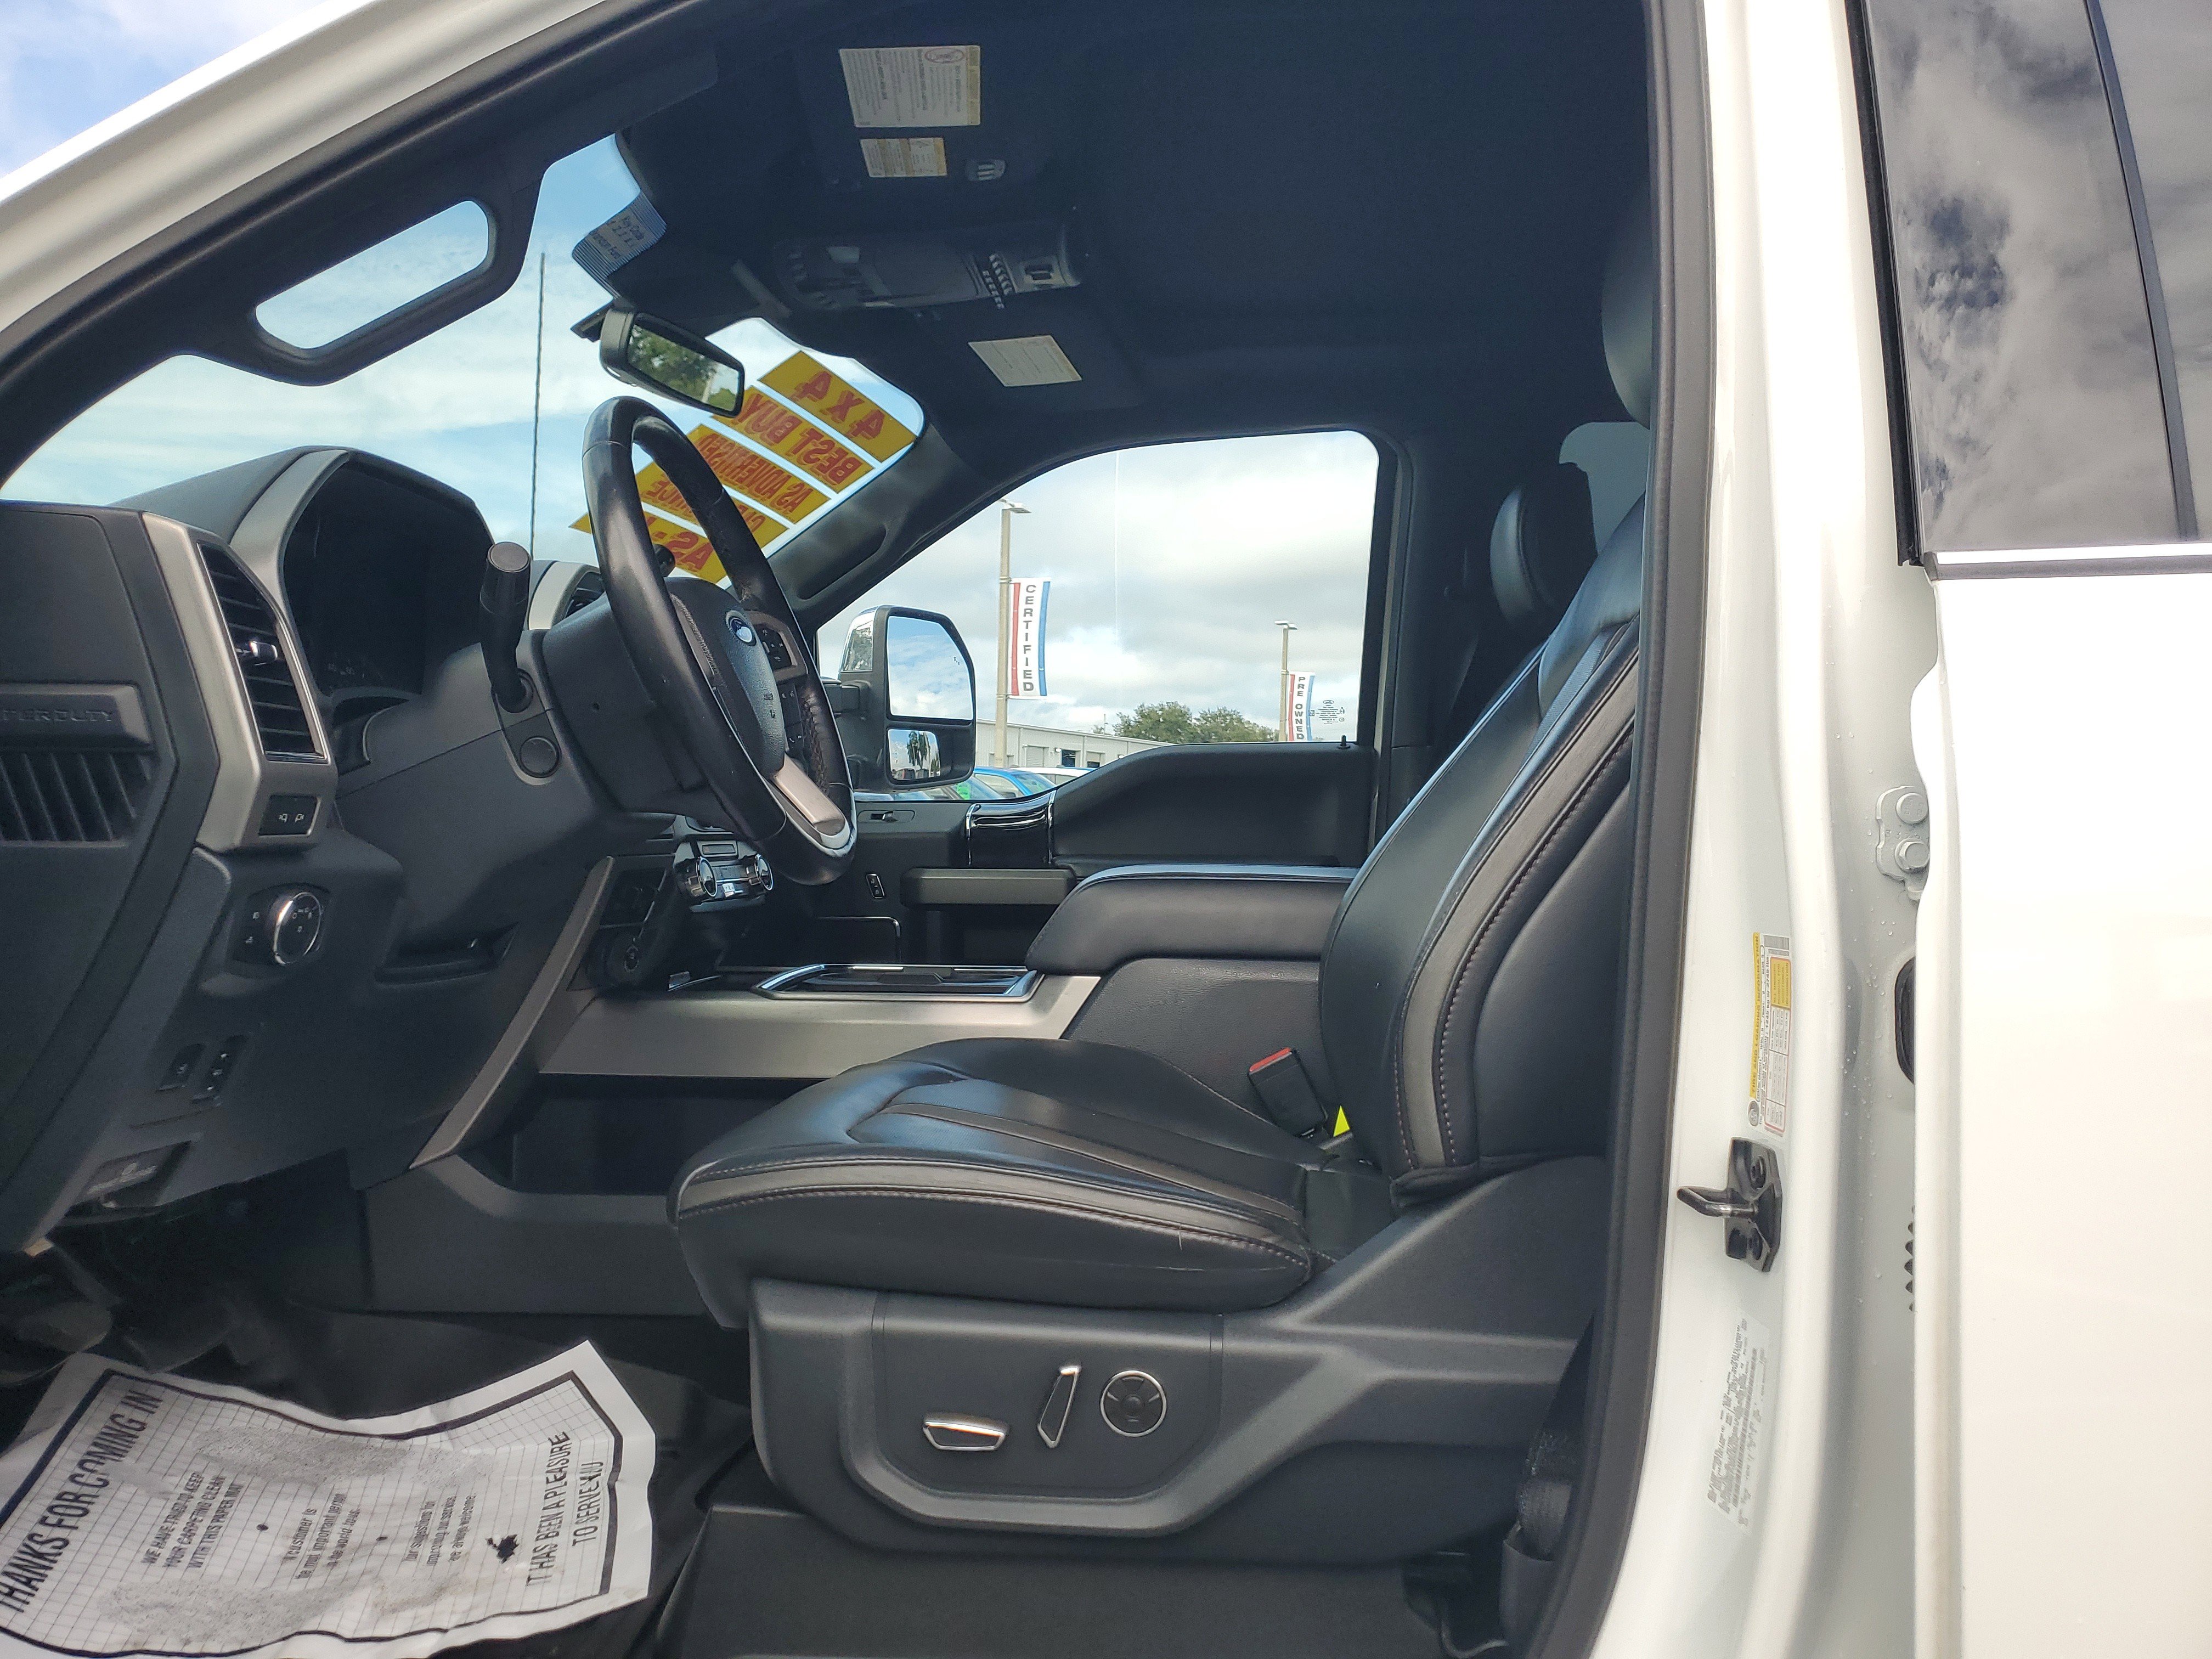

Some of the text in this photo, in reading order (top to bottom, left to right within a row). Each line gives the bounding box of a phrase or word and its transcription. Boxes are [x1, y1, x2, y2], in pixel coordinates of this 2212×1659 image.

[1023, 584, 1037, 692] CERTIFIED
[1295, 676, 1306, 740] PRE OWNED
[544, 1431, 572, 1499] PLEASURE
[0, 1533, 70, 1614] THANKS
[38, 1491, 100, 1531] FOR
[121, 1389, 163, 1415] IN
[141, 1471, 204, 1564] WE HAVE TRIED TO KEEP
[163, 1475, 226, 1567] YOUR CARPETING CLEAN
[542, 1499, 566, 1510] A
[575, 1481, 601, 1523] SERVE
[188, 1482, 243, 1568] WITH THIS PAPER MAT
[286, 1517, 312, 1555] customer
[312, 1515, 336, 1551] important
[335, 1527, 352, 1548] world
[534, 1510, 564, 1541] BEEN
[572, 1526, 598, 1546] TO
[529, 1544, 558, 1570] HAS
